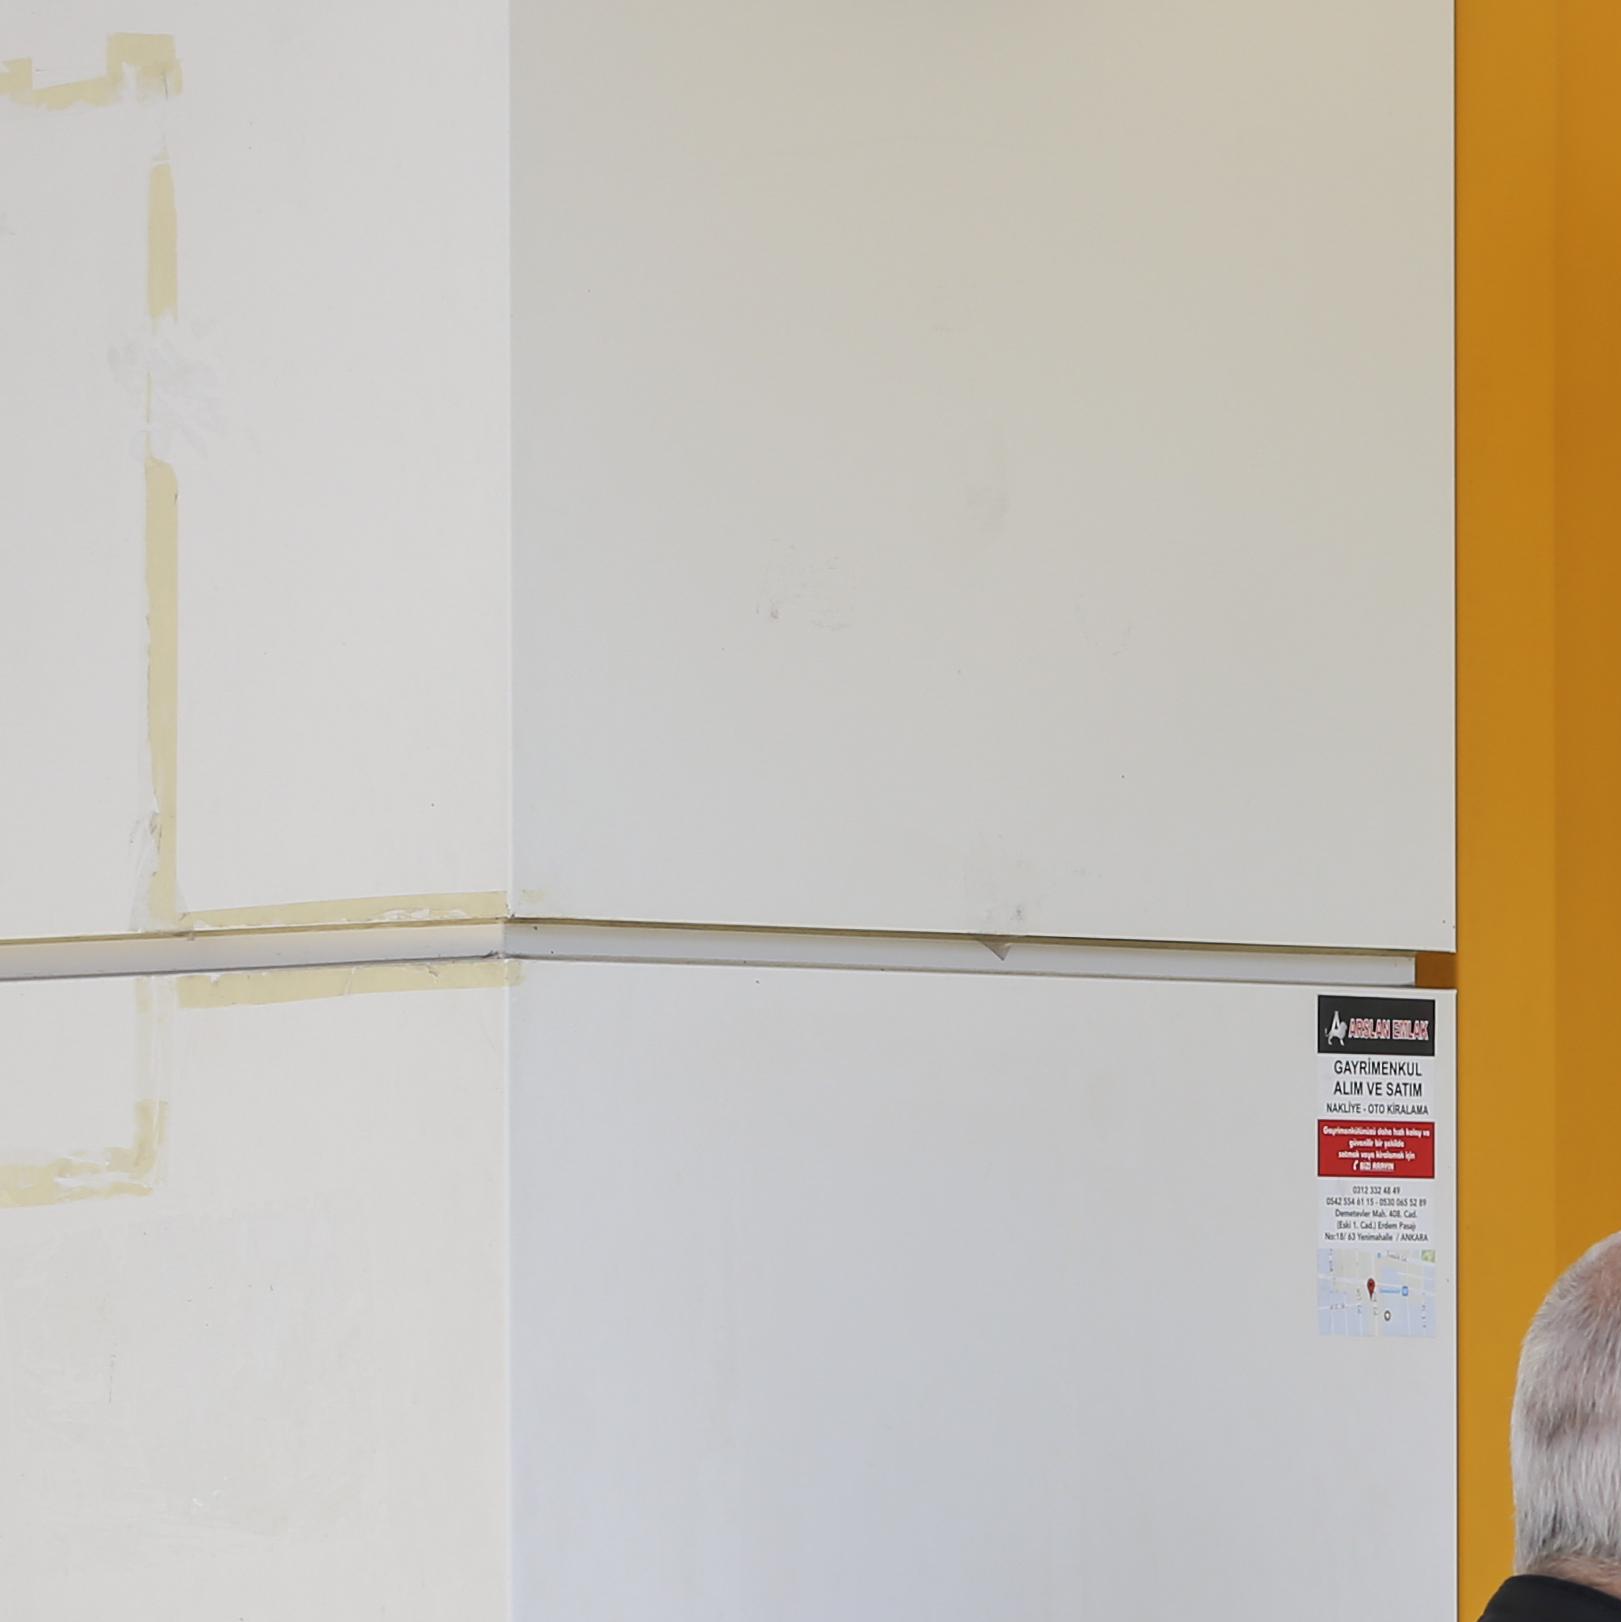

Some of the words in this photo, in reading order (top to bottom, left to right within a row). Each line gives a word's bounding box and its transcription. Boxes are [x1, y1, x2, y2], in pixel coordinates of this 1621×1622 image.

[1348, 1018, 1391, 1039] ARSLAN
[1392, 1020, 1429, 1040] EMLAK
[1334, 1057, 1422, 1077] GAYRİMENKUL
[1333, 1081, 1363, 1096] ALIM
[1367, 1082, 1382, 1096] VE
[1386, 1082, 1423, 1097] SATIM
[1326, 1101, 1361, 1114] NAKLİYE
[1367, 1103, 1385, 1115] OTO
[1387, 1102, 1429, 1116] KİRALAMA
[1400, 1233, 1429, 1242] ANKARA
